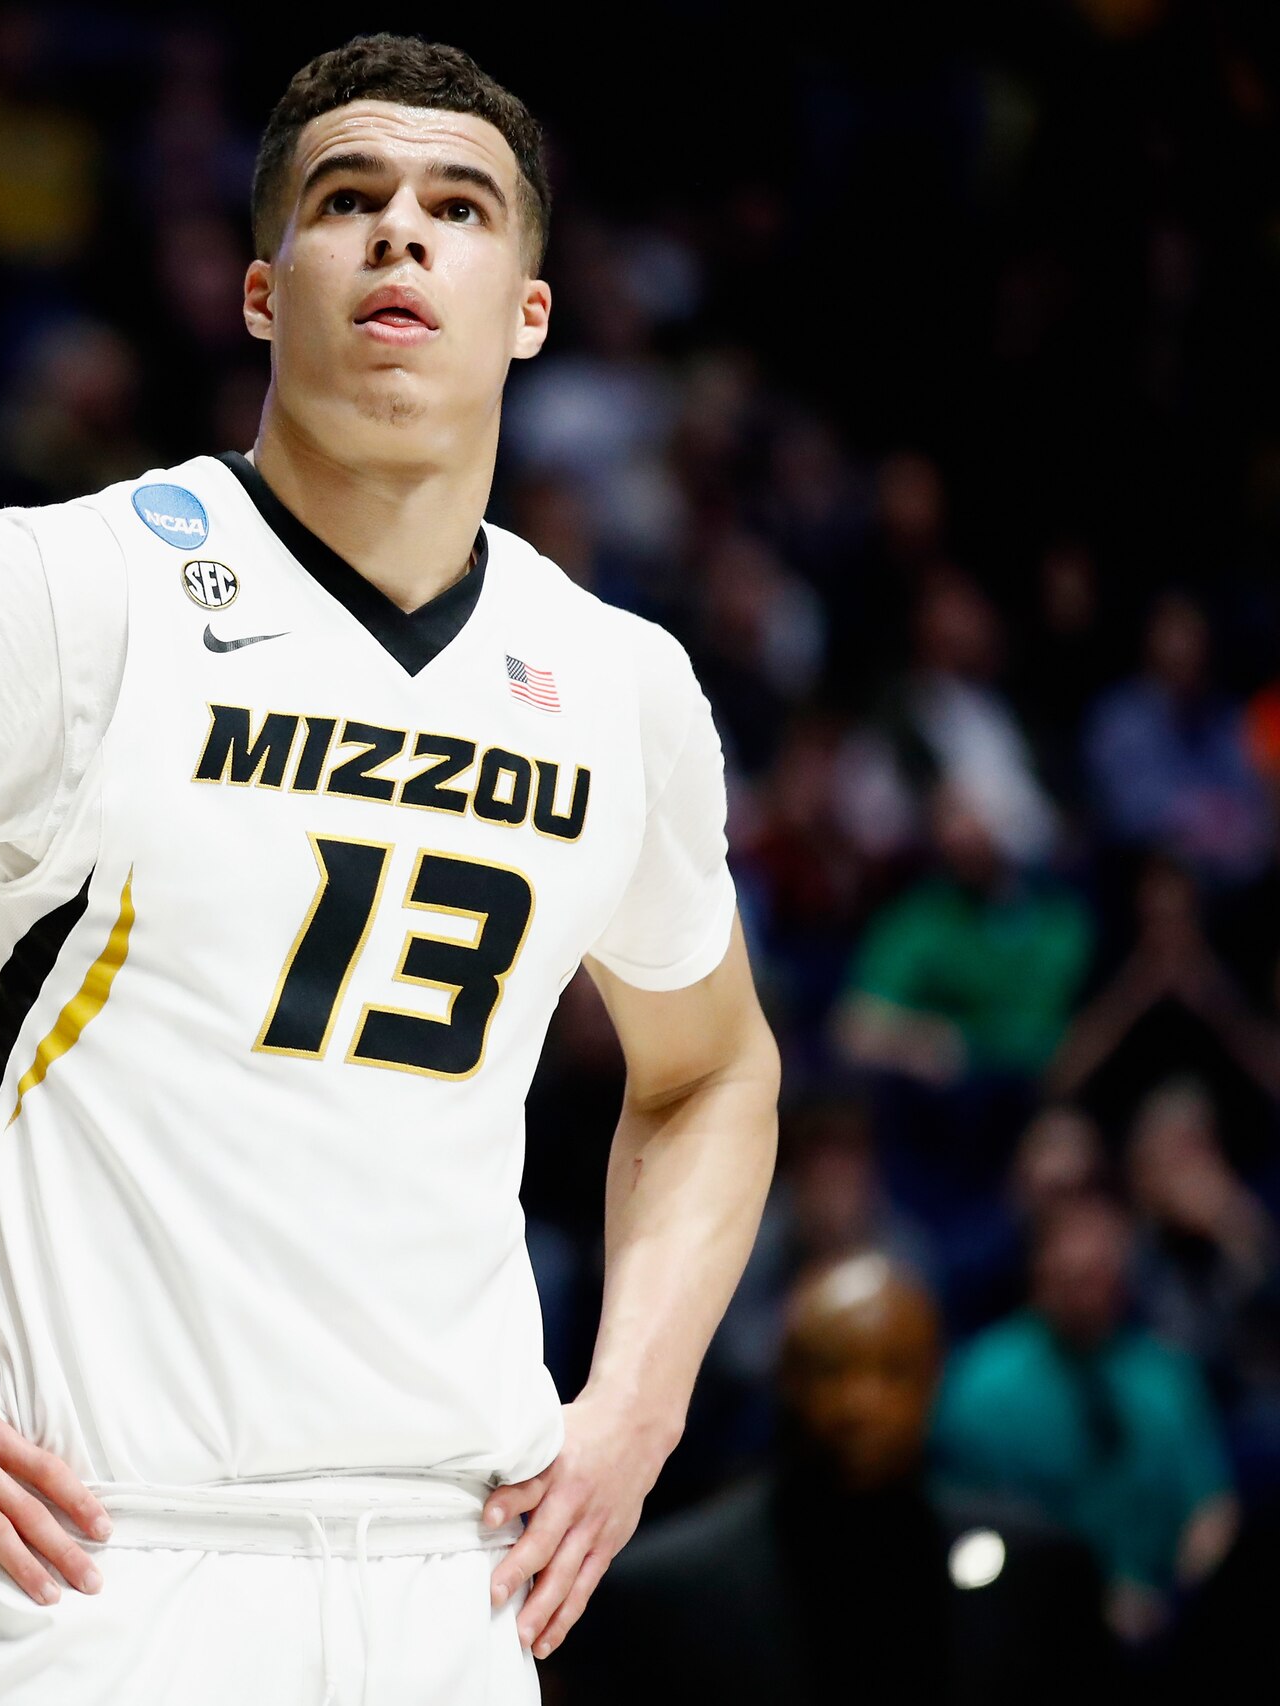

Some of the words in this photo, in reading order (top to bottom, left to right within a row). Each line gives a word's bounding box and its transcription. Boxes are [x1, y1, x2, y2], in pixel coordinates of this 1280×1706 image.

[144, 509, 207, 537] NCAA
[184, 560, 238, 607] SEC
[191, 701, 592, 844] MIZZOU
[251, 831, 537, 1082] 13
